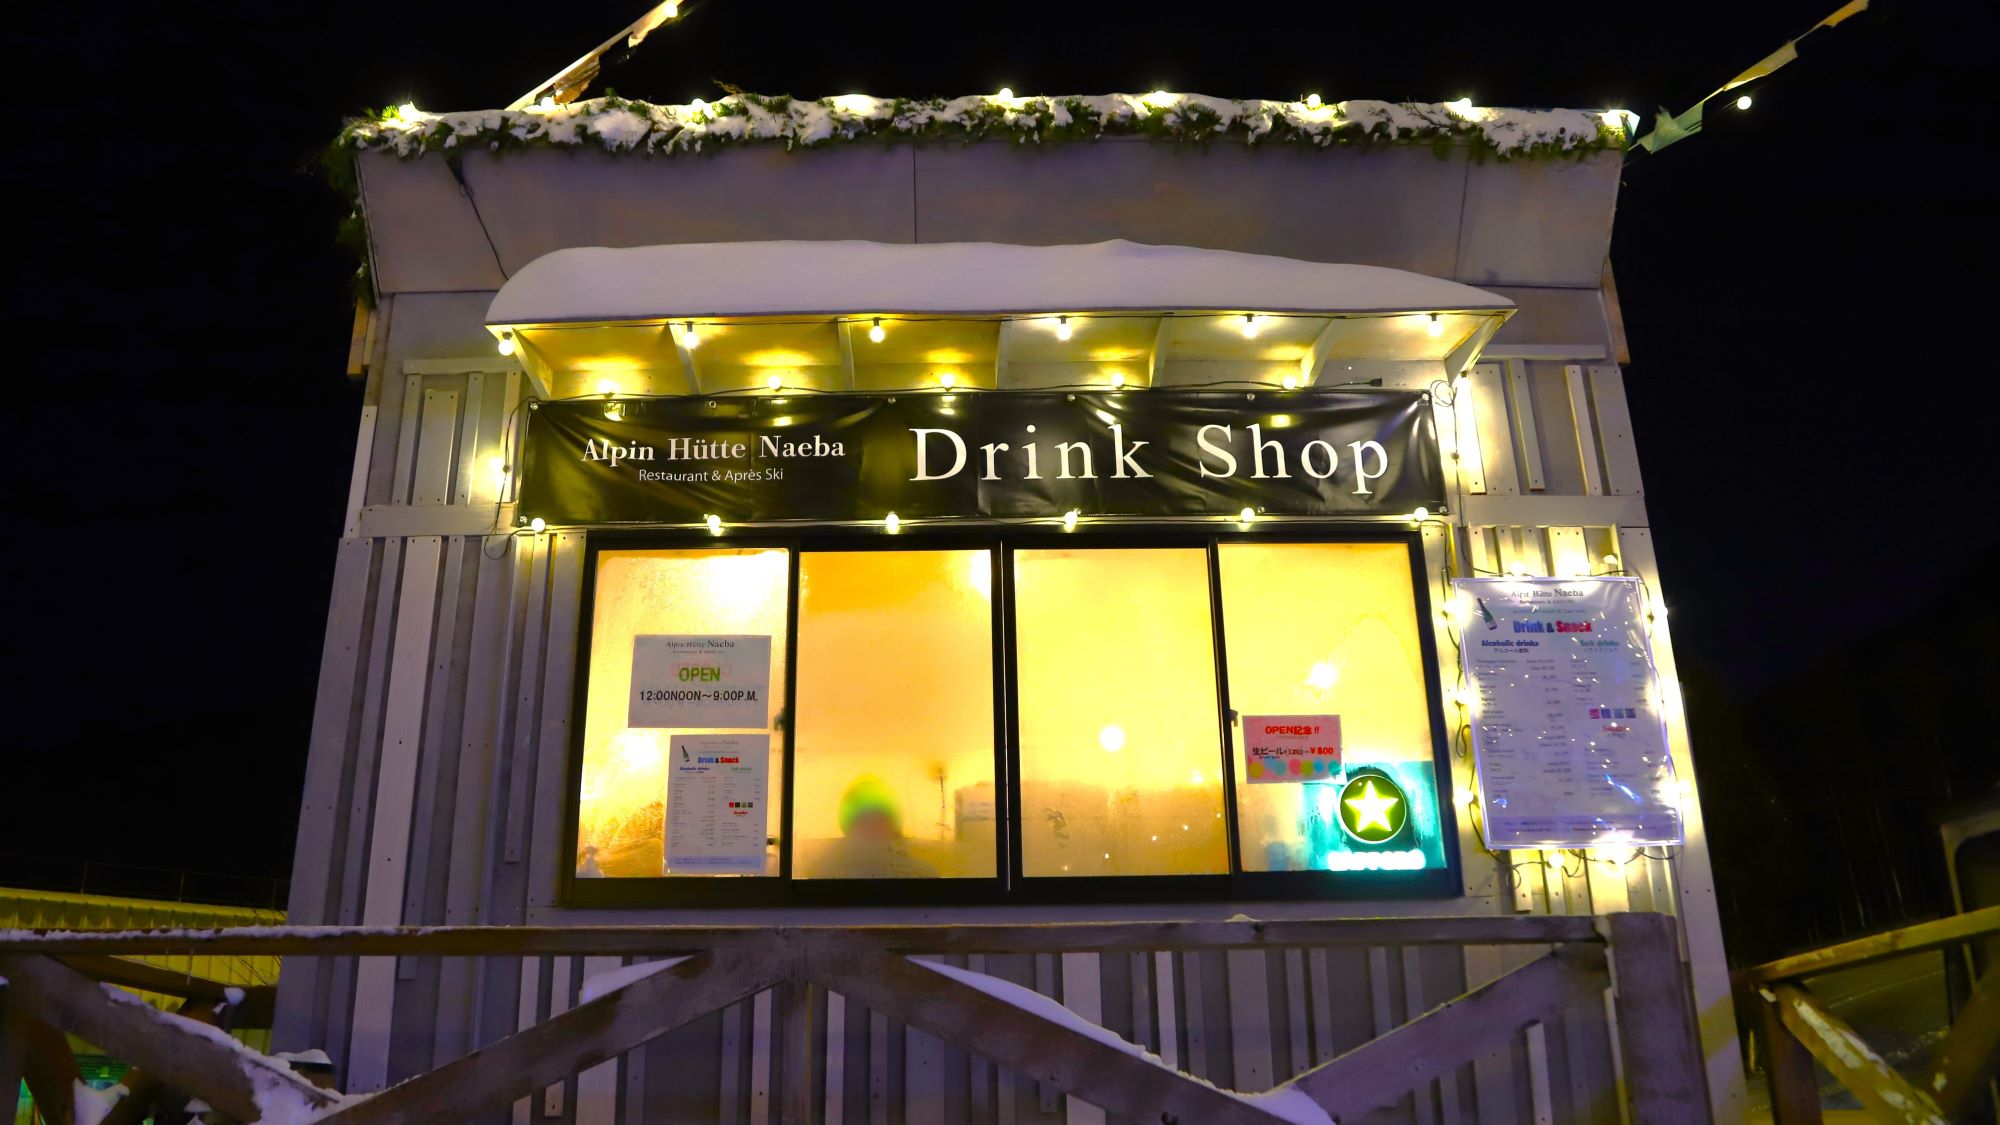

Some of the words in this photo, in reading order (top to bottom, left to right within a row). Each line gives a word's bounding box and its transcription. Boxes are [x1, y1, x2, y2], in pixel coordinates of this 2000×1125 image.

[581, 438, 655, 468] Alpin
[667, 436, 747, 462] Hütte
[758, 435, 846, 459] Naeba
[909, 423, 1154, 482] Drink
[1197, 423, 1389, 495] Shop
[638, 468, 709, 483] Restaurant
[711, 469, 722, 482] &
[724, 468, 762, 484] Après
[765, 467, 784, 481] Ski
[1554, 588, 1584, 598] Naeba
[1512, 620, 1545, 633] Drink
[1546, 622, 1555, 633] &
[1556, 620, 1592, 633] Snack
[707, 639, 735, 649] Naeba
[1481, 639, 1514, 647] Alcoholic
[1515, 639, 1539, 647] drinks
[678, 667, 721, 682] OPEN
